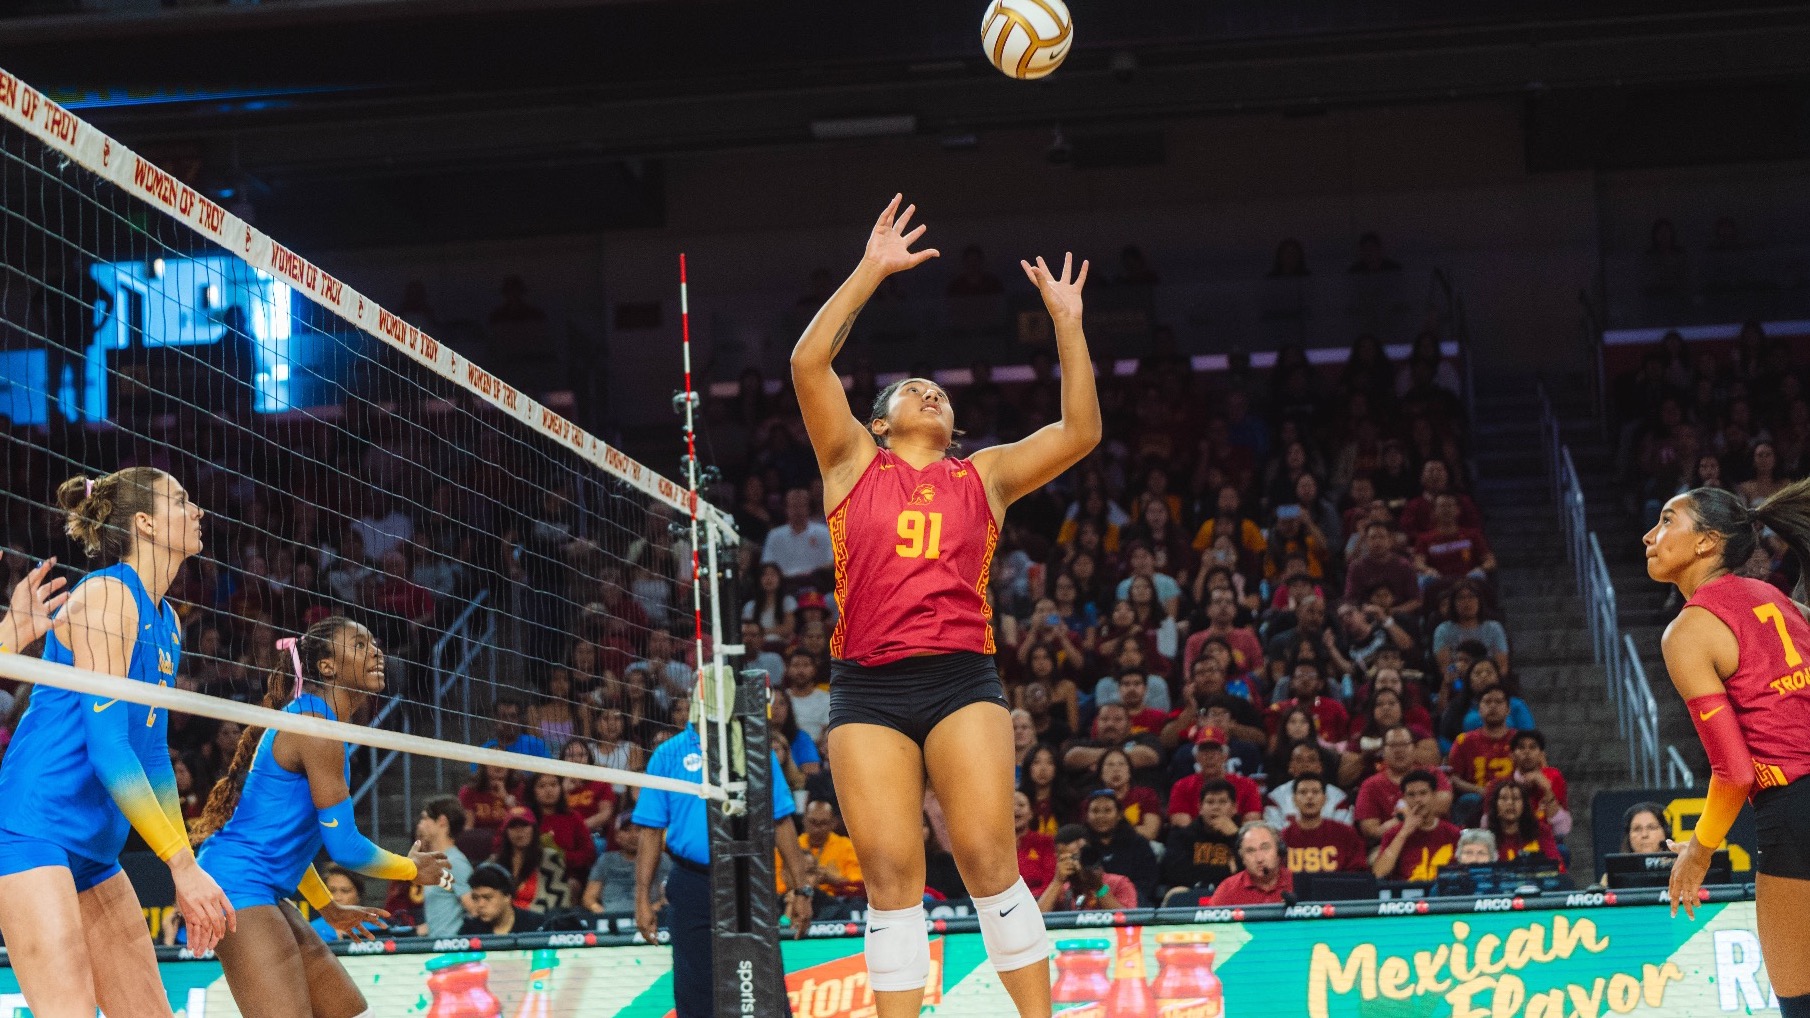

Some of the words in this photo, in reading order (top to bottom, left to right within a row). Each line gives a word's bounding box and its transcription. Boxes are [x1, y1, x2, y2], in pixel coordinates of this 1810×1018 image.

[21, 85, 40, 121] OF
[44, 100, 78, 146] TROY
[134, 156, 179, 209] WOMEN
[179, 186, 196, 217] OF
[198, 198, 225, 236] TROY
[271, 241, 306, 284] WOMEN
[306, 262, 318, 292] OF
[321, 271, 343, 306] TROY
[379, 307, 406, 345] WOMEN
[409, 326, 418, 351] OF
[420, 333, 439, 363] TROY
[895, 510, 943, 559] 91
[1752, 602, 1803, 668] 7
[1287, 845, 1338, 873] USC
[1474, 899, 1512, 911] ARCO
[1566, 894, 1604, 906] ARCO
[1284, 905, 1323, 917] ARCO
[1378, 902, 1416, 914] ARCO
[1076, 912, 1113, 925] ARCO
[1194, 909, 1232, 922] ARCO
[808, 924, 846, 935] ARCO
[549, 934, 585, 946] ARCO
[632, 931, 671, 943] AO
[348, 942, 385, 953] ARCO
[433, 938, 470, 950] ARCO
[1308, 915, 1610, 1018] Mexican
[1445, 961, 1685, 1018] Flavor
